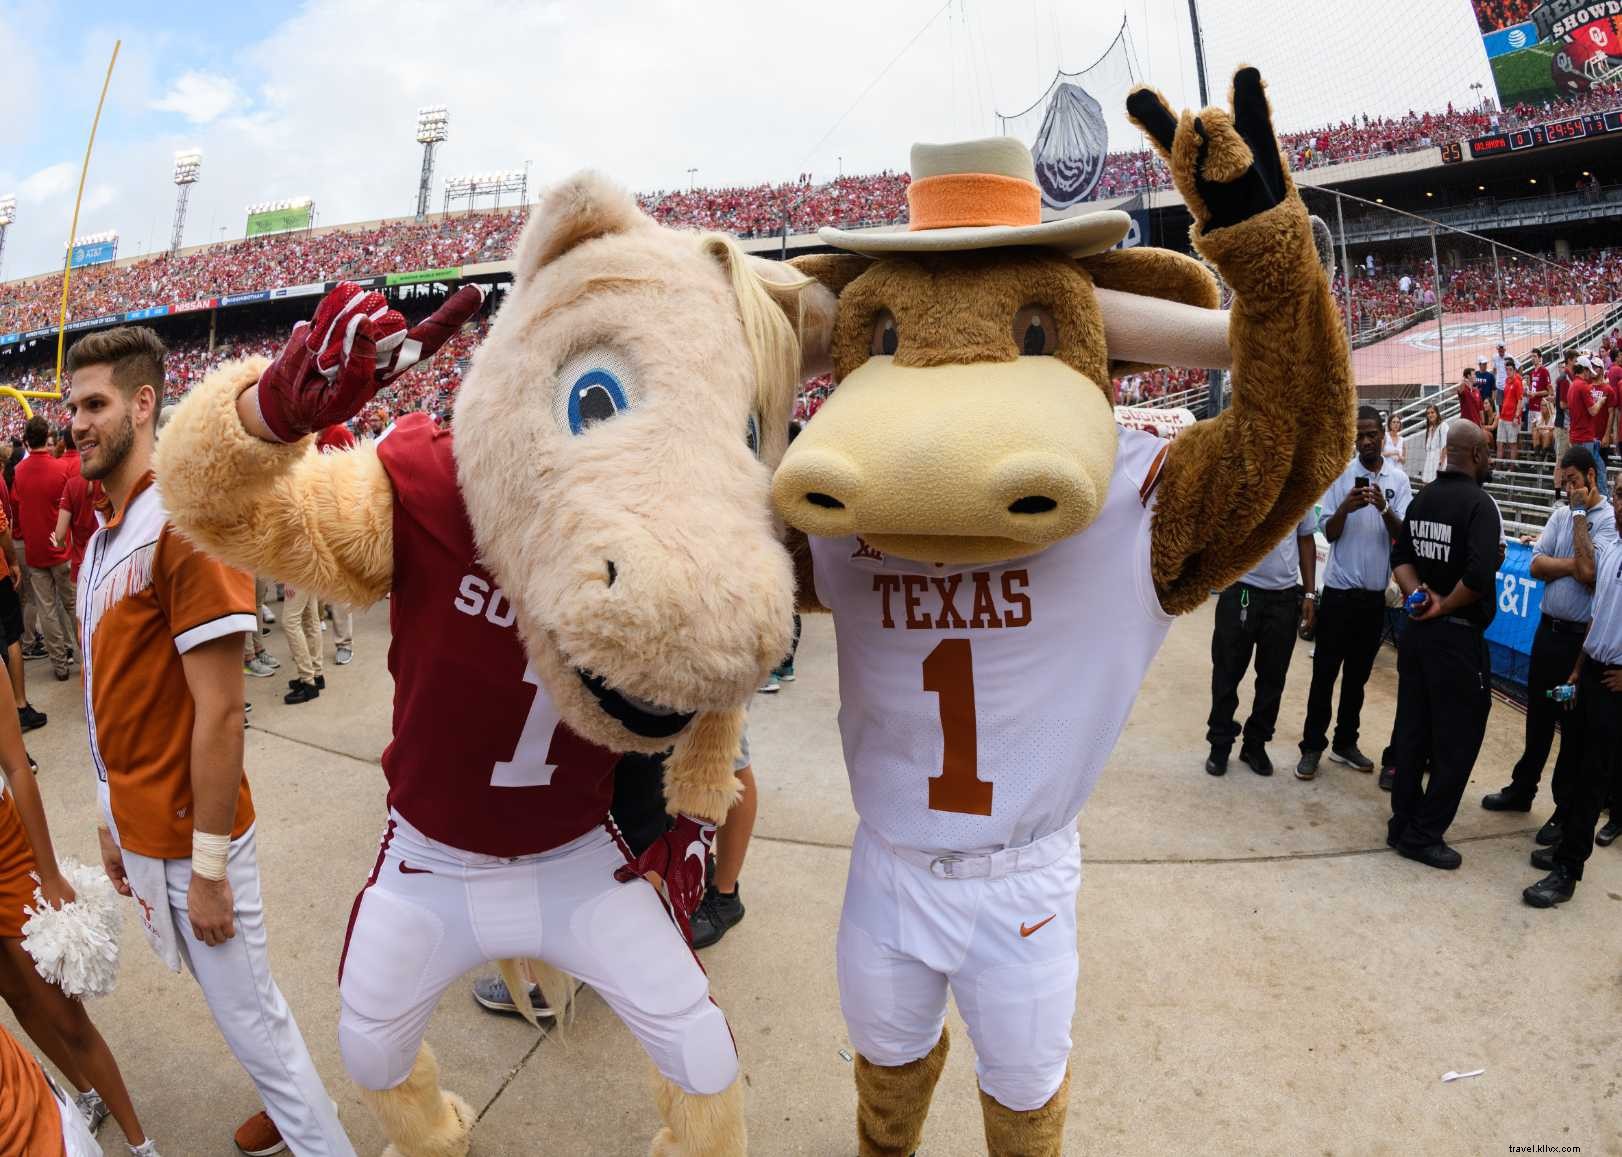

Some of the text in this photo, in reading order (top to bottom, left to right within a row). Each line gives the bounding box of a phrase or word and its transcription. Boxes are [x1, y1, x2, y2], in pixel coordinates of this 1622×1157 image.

[1552, 0, 1622, 39] SHOWD
[1442, 143, 1460, 161] 25
[174, 300, 210, 313] NISSAN
[1410, 520, 1452, 543] PLATINUM
[872, 569, 1032, 629] TEXAS
[489, 655, 561, 787] 1
[922, 638, 994, 817] 1
